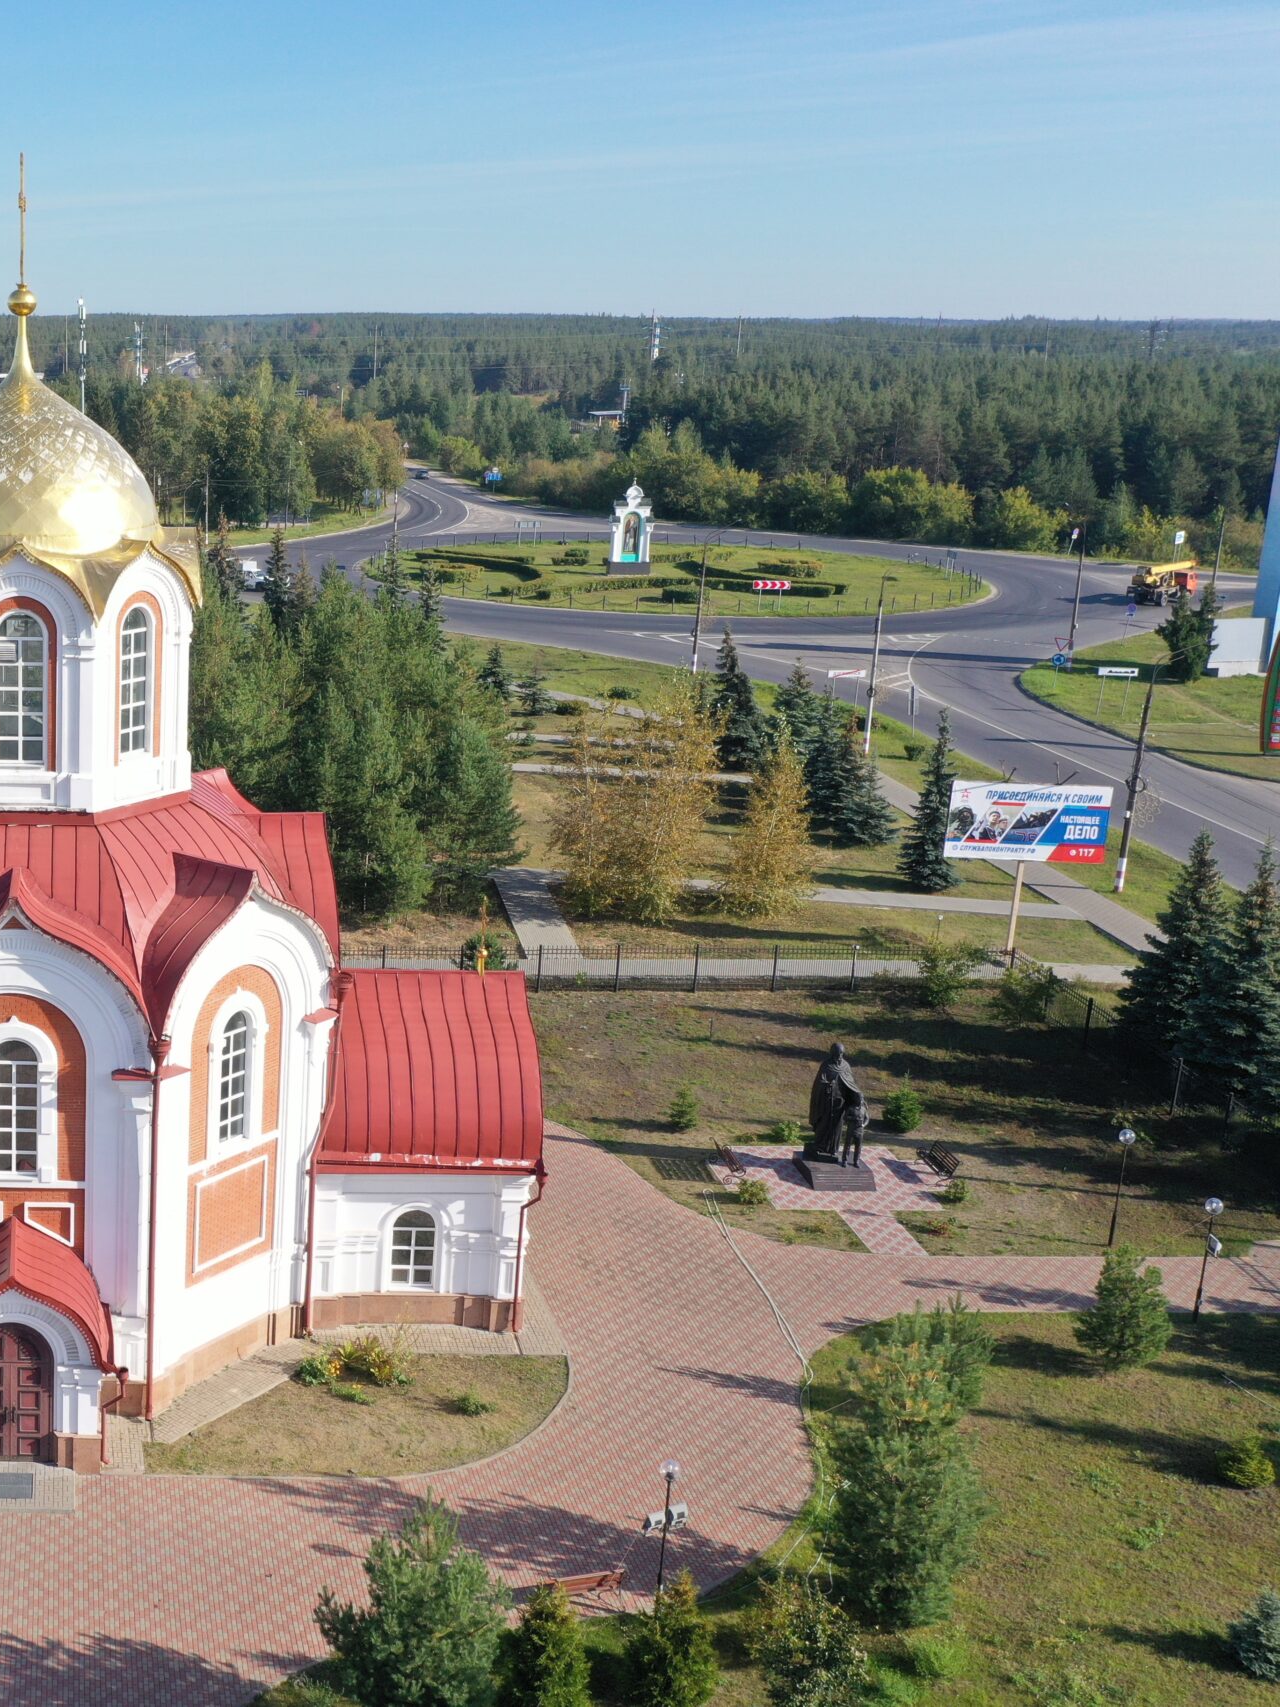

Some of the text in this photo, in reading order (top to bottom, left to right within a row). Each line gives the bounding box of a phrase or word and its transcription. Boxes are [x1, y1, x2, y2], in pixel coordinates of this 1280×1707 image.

[986, 790, 1103, 804] ПРИСОЕДИНЯЙСЯ К СВОИМ
[1060, 815, 1100, 825] НАСТОЯЩЕЕ
[1064, 825, 1099, 840] ДЕЛО
[1078, 848, 1095, 857] 117
